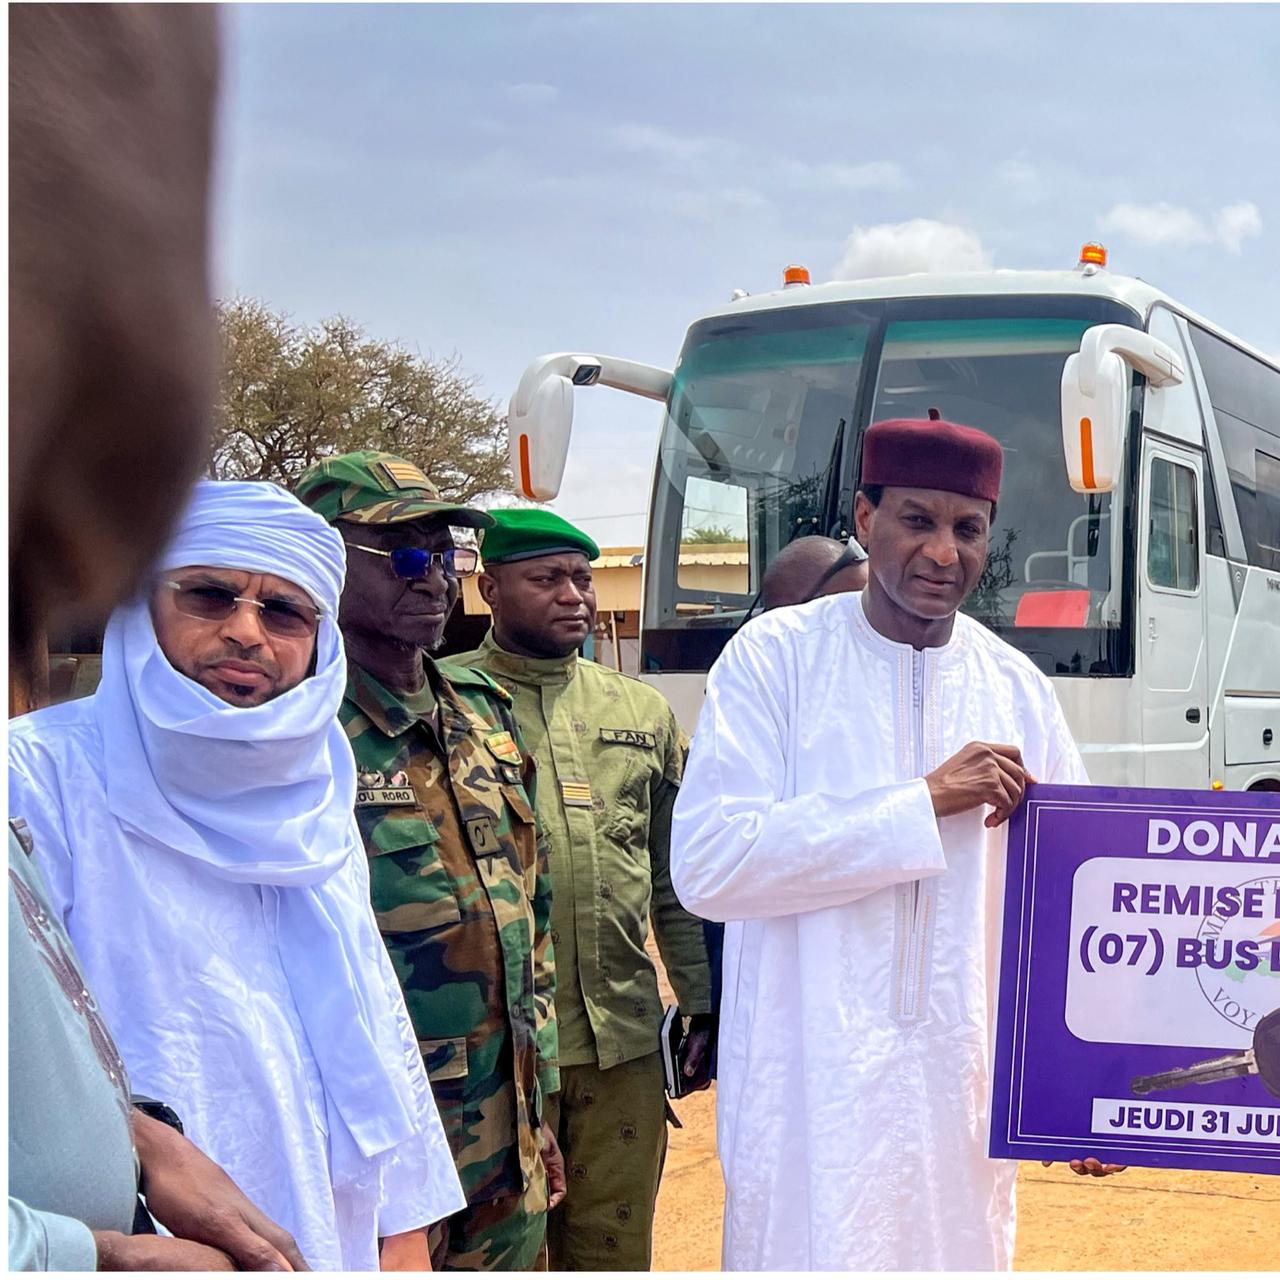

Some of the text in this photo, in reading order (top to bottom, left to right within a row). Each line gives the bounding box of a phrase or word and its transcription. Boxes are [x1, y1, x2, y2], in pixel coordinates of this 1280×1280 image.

[613, 731, 647, 744] FAN
[382, 791, 410, 801] RORO
[1112, 882, 1265, 918] REMISE
[1079, 925, 1165, 976] (07)
[1176, 937, 1260, 971] BUS
[1108, 1106, 1195, 1132] JEUDI
[1202, 1110, 1230, 1134] 31
